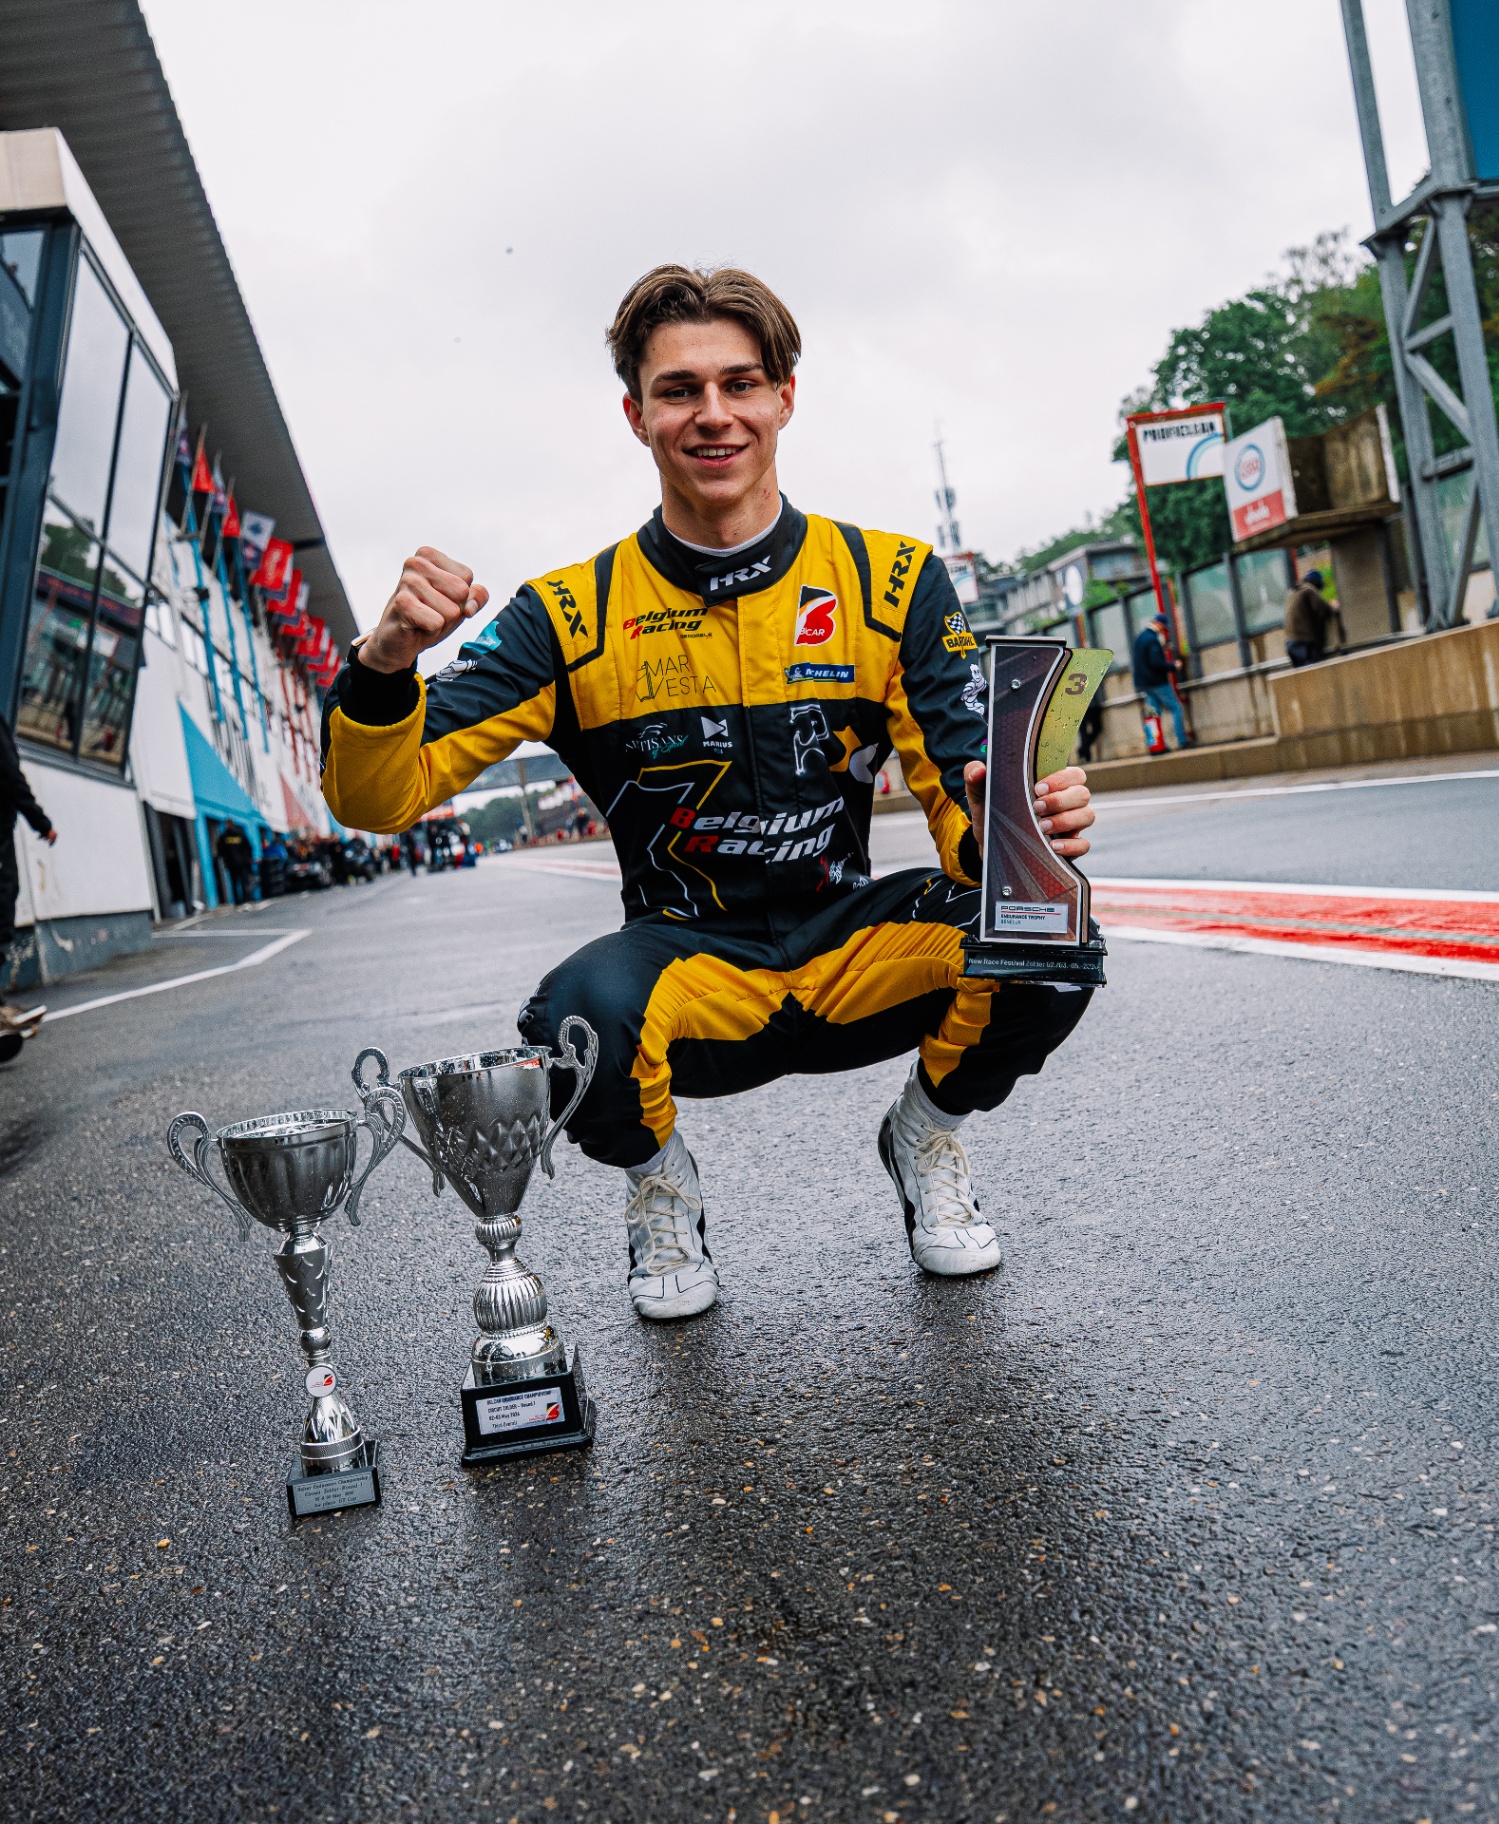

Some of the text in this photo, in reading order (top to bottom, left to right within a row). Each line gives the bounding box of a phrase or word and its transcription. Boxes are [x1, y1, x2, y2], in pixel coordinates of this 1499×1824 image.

[710, 555, 772, 591] HRX
[884, 541, 916, 608] HRX
[546, 580, 589, 640] HRX
[623, 607, 709, 631] Belgium
[630, 619, 703, 640] Racing
[1064, 673, 1088, 695] 3
[669, 796, 846, 837] Belgium
[683, 823, 836, 864] Racing
[1000, 905, 1056, 913] PORSCHE
[983, 958, 999, 966] Race
[1000, 959, 1025, 967] Festival
